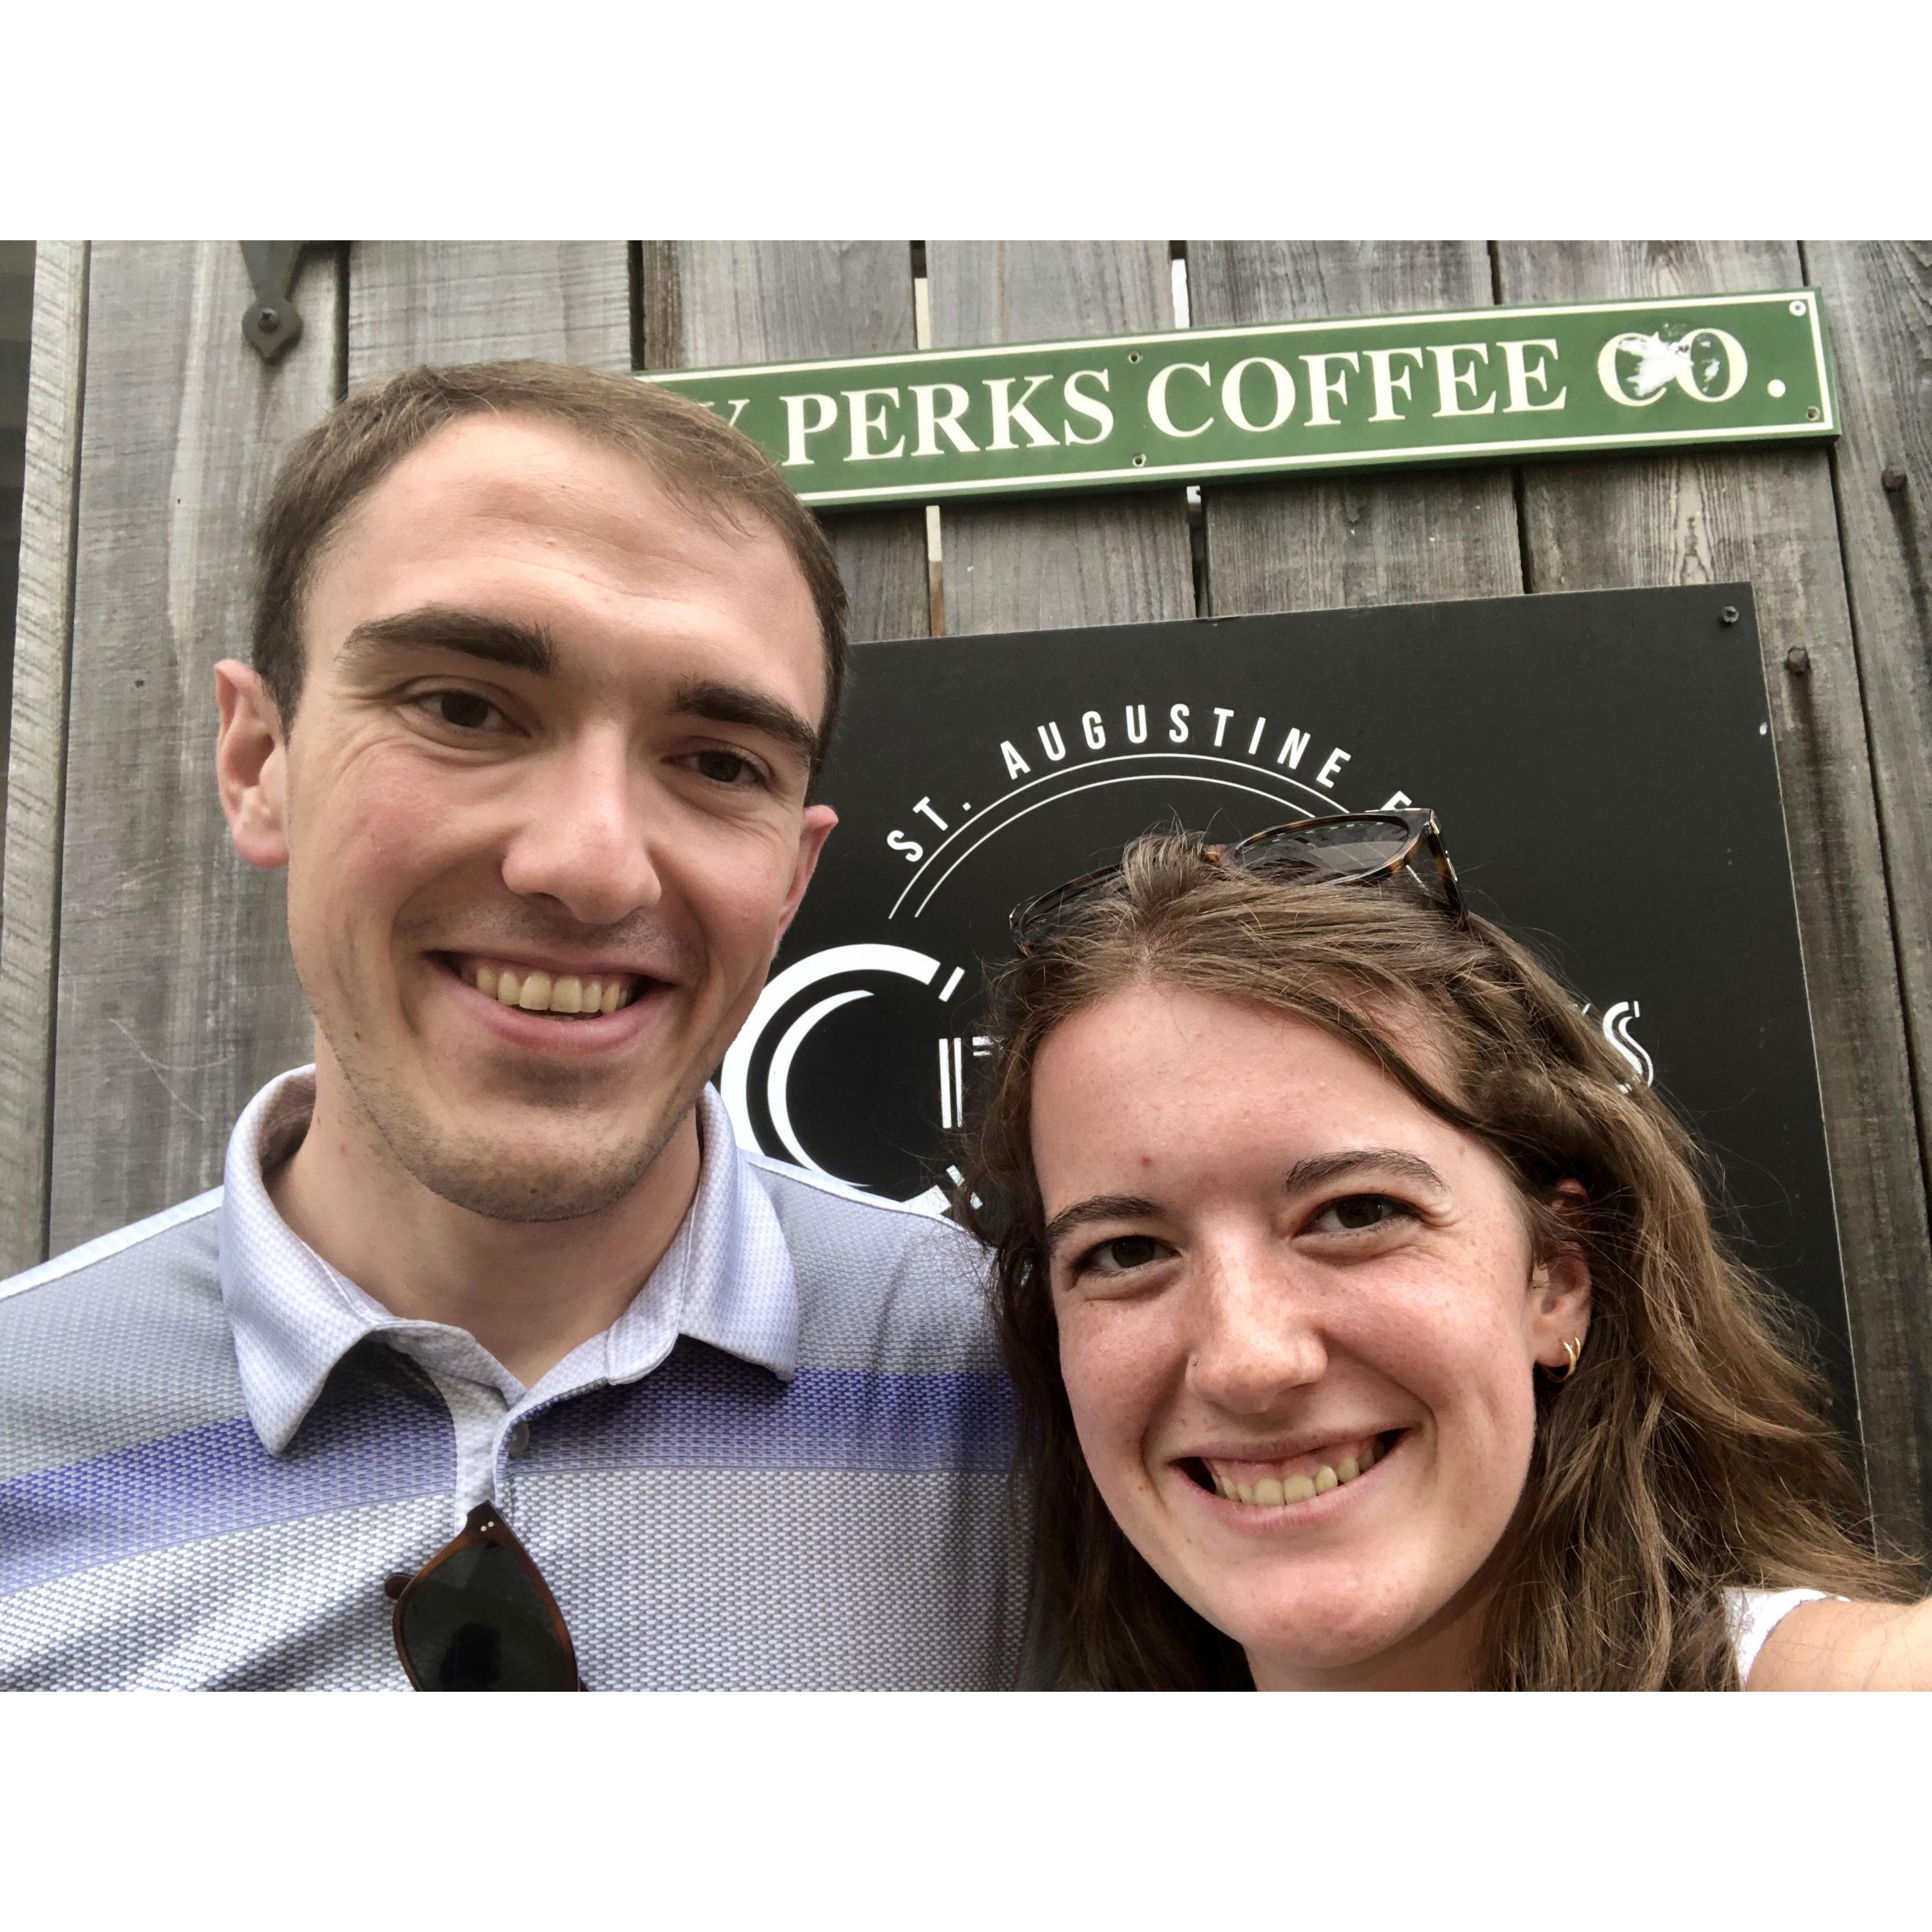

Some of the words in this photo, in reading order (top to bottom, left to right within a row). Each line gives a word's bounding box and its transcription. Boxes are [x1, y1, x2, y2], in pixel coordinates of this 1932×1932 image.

[780, 368, 1114, 467] PERKS
[1146, 338, 1568, 438] COFFEE
[1597, 327, 1786, 407] CO.
[887, 796, 972, 862] ST.
[1000, 703, 1351, 789] AUGUSTINE
